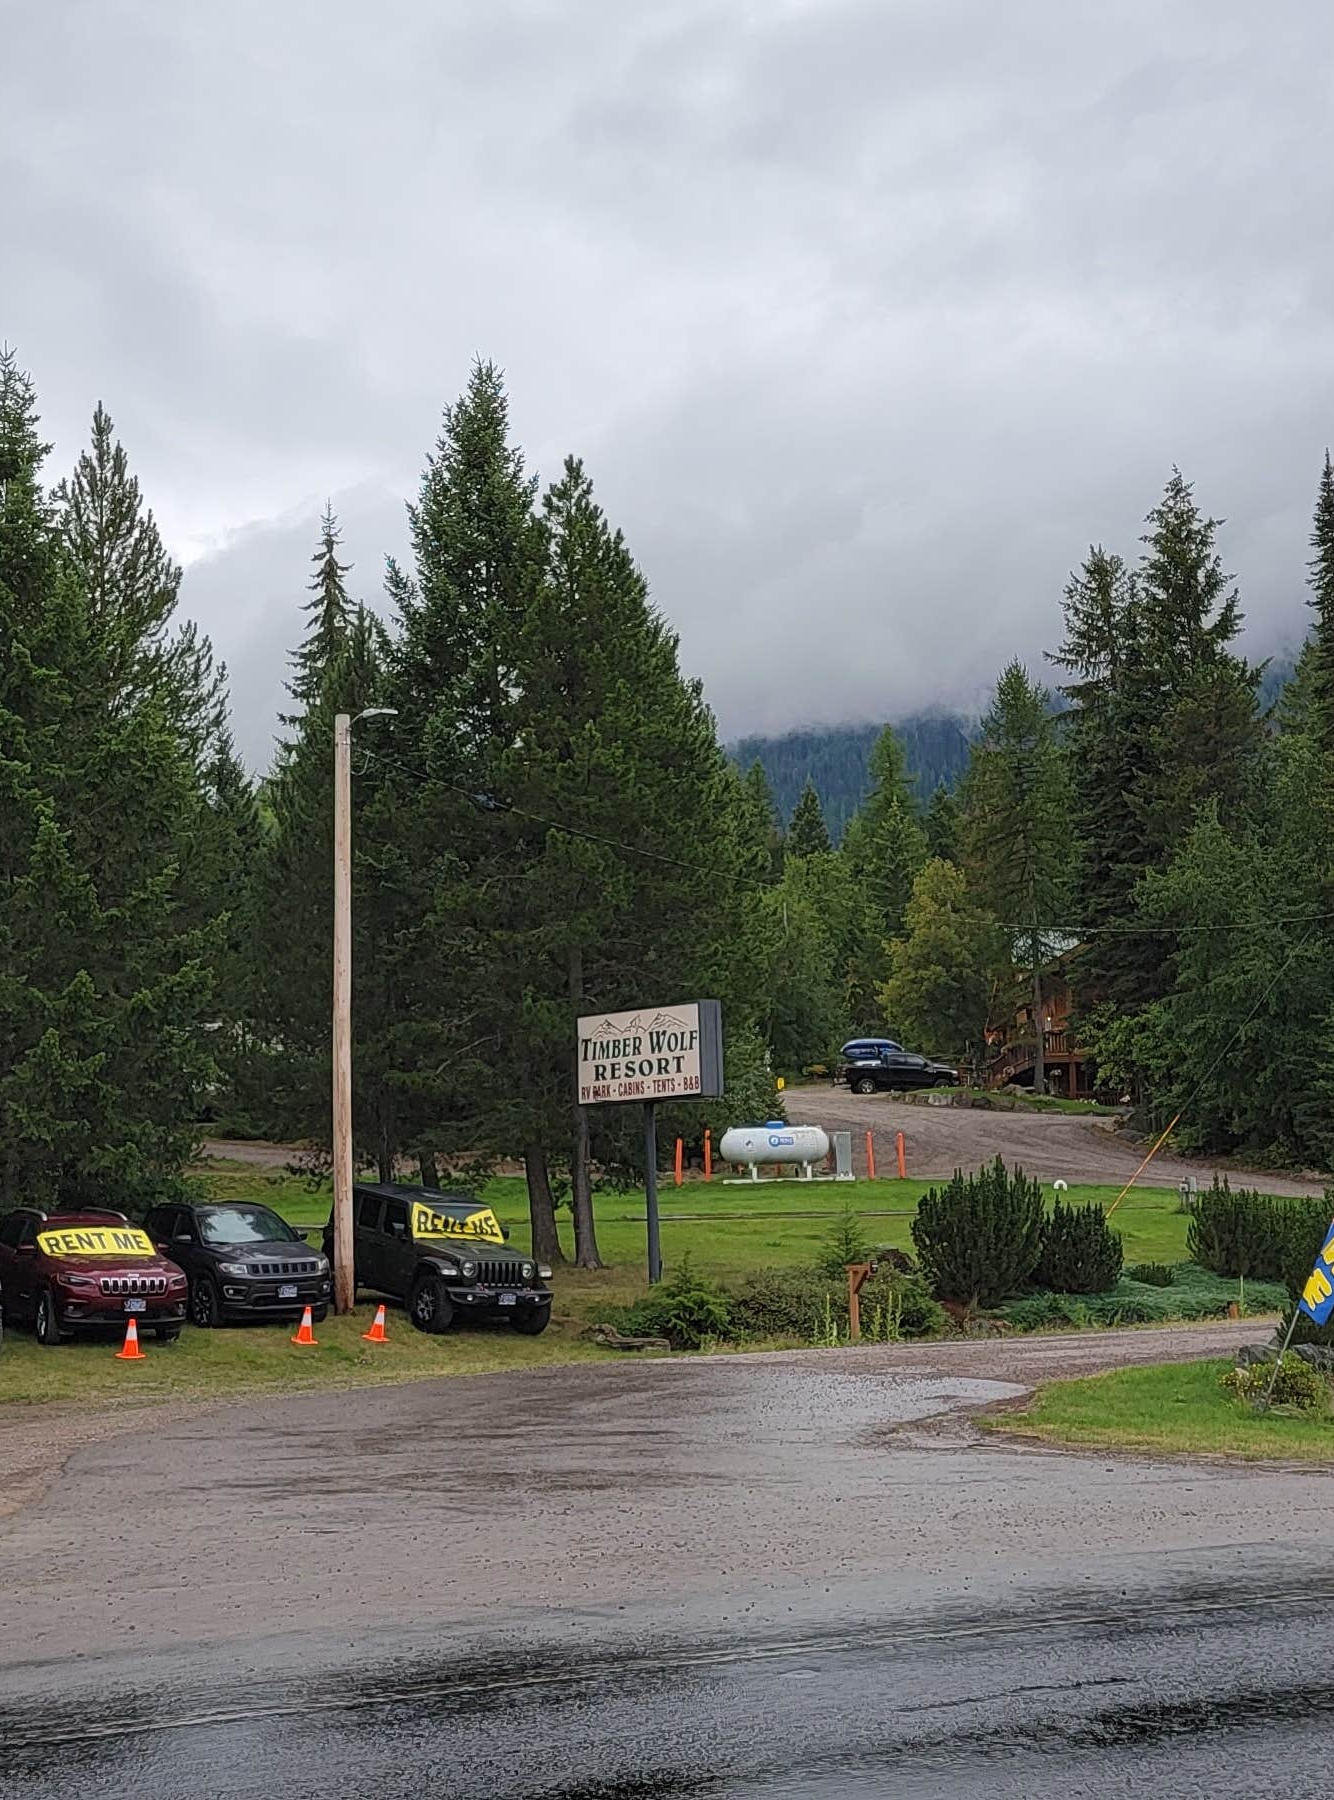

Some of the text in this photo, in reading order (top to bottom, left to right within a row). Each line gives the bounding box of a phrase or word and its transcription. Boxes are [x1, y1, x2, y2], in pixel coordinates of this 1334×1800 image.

[581, 1030, 698, 1062] TIMBER WOLF
[594, 1055, 685, 1082] RESORT
[581, 1086, 592, 1100] RV
[593, 1084, 612, 1099] PARK
[618, 1080, 645, 1097] CABINS
[652, 1078, 676, 1094] TENTS
[683, 1075, 700, 1091] B&B
[44, 1232, 150, 1254] RENT ME
